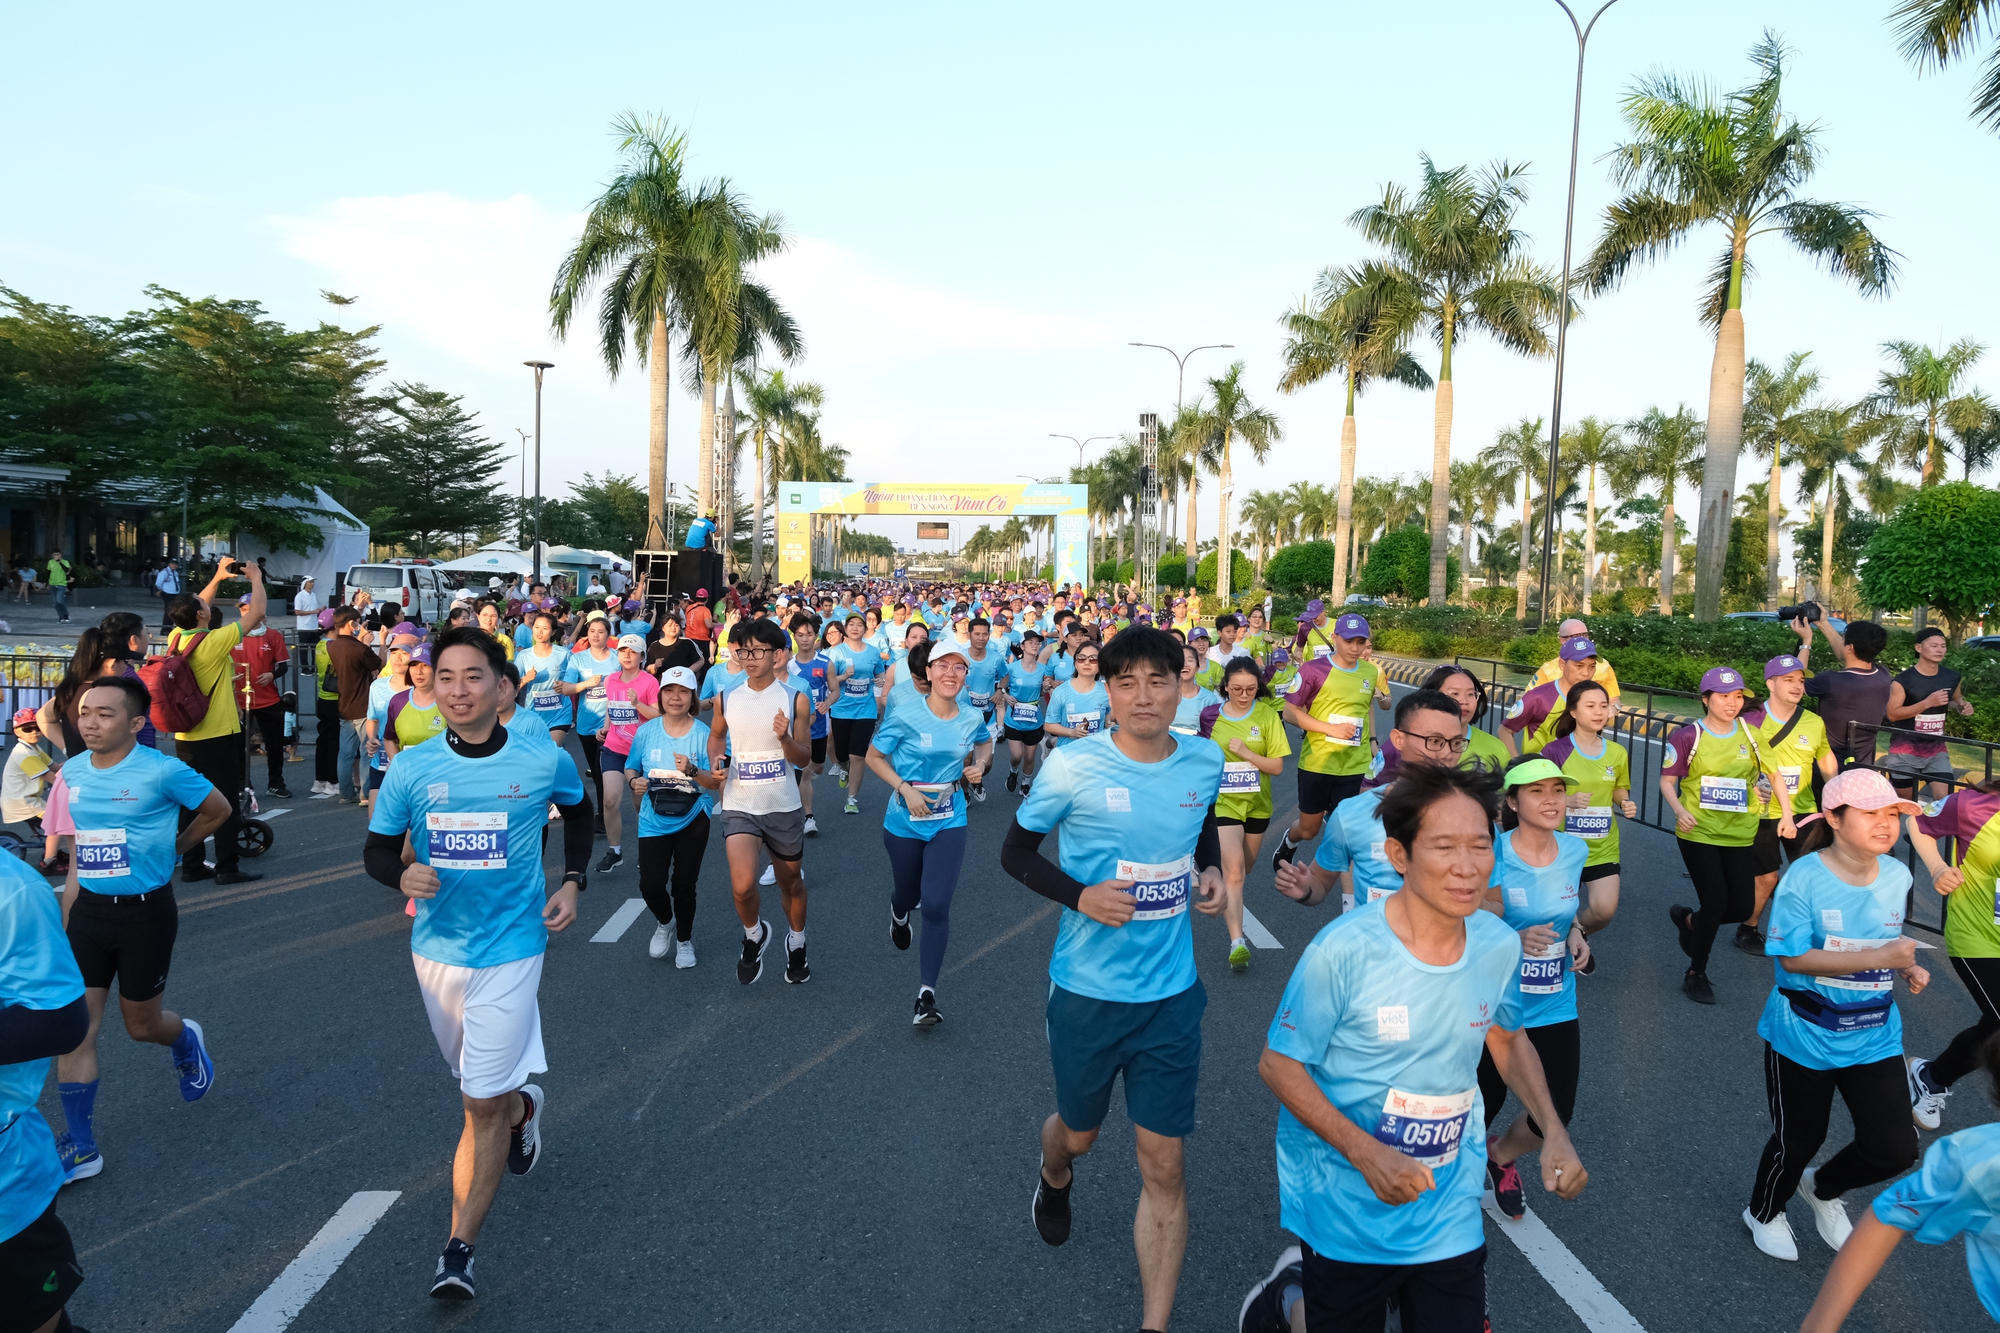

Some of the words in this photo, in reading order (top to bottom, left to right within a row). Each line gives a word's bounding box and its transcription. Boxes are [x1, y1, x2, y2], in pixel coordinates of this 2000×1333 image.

[863, 488, 894, 503] Ngắm
[950, 494, 985, 511] Vàm
[986, 494, 1008, 512] Cỏ
[1060, 517, 1084, 528] START
[1060, 532, 1084, 542] FINISH
[749, 762, 780, 774] 05105
[1228, 772, 1256, 783] 05738
[1712, 789, 1742, 801] 05651
[1577, 818, 1608, 828] 05688
[445, 833, 496, 850] 05381
[82, 847, 121, 862] 05129
[1136, 878, 1184, 902] 05383
[1521, 961, 1560, 977] 05164
[1387, 1116, 1397, 1126] 5
[1382, 1125, 1396, 1134] KM
[1403, 1118, 1462, 1145] 05106
